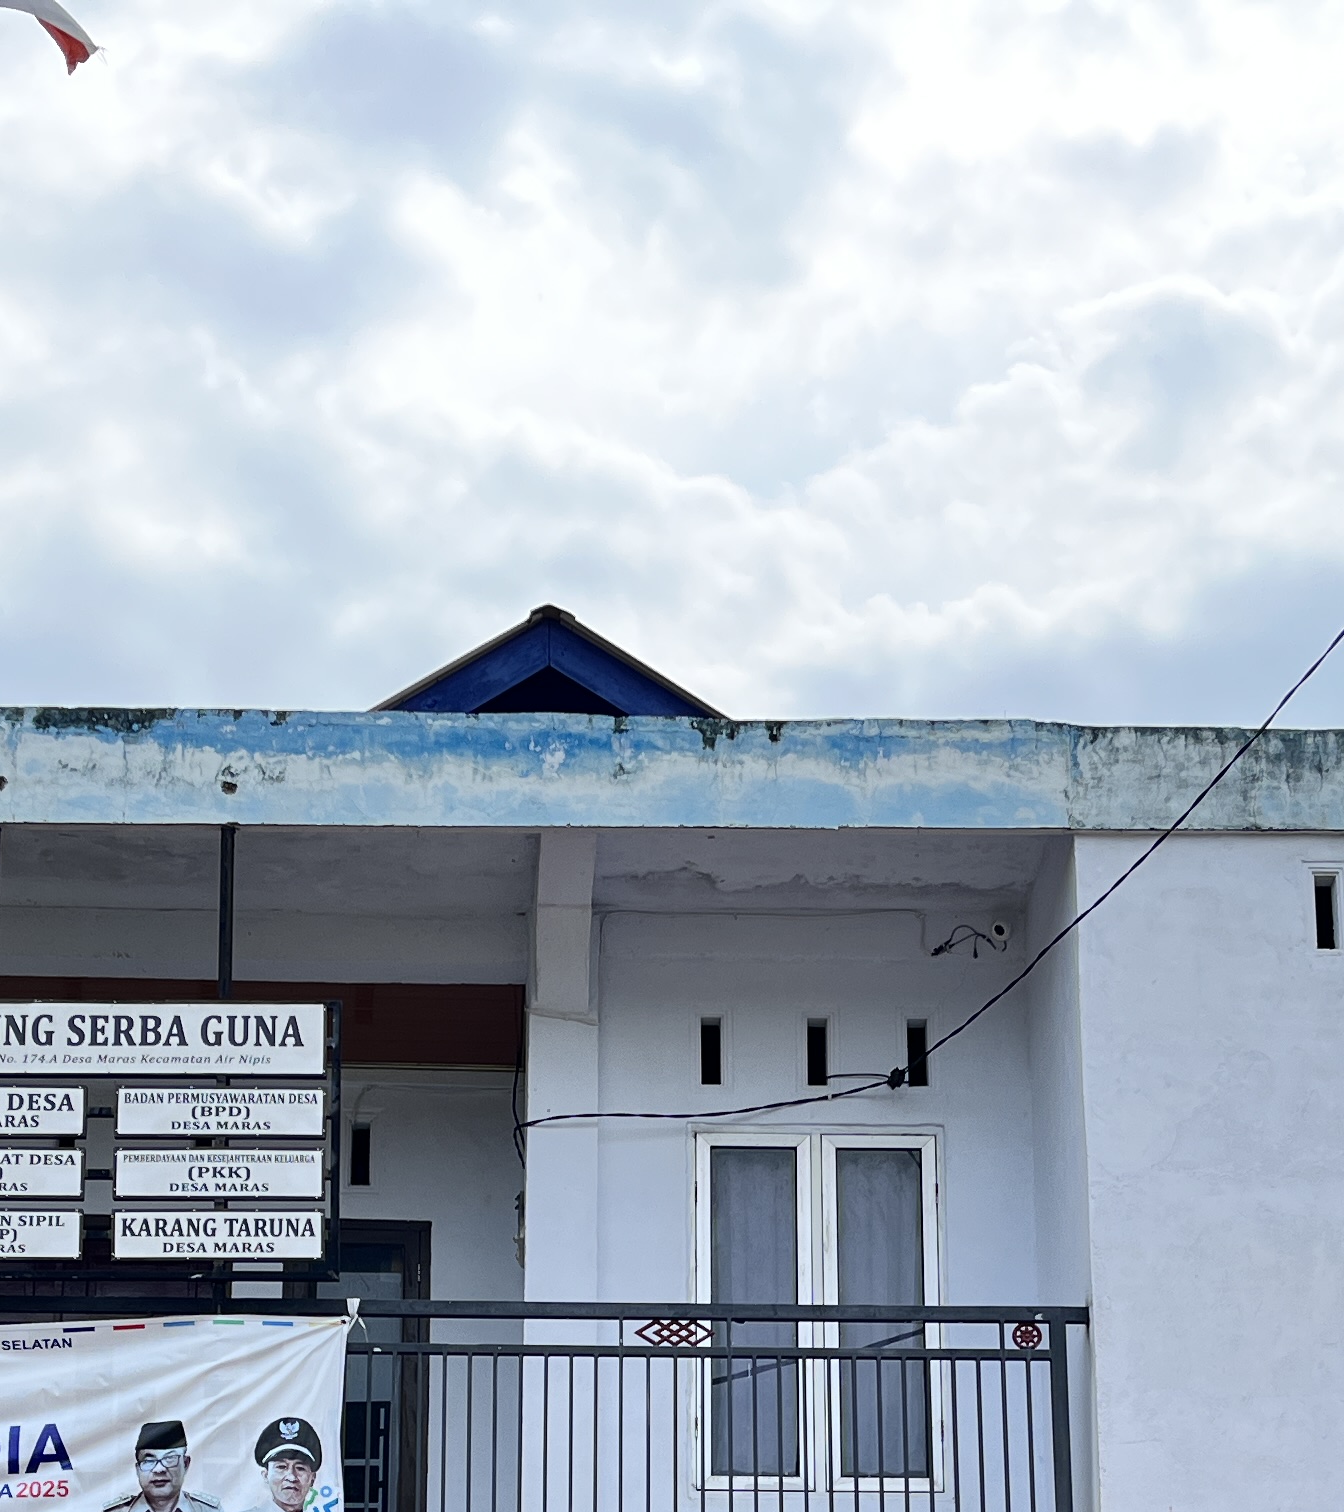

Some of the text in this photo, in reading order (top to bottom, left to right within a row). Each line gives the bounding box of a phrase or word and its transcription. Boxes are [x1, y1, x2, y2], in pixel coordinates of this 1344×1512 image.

[66, 1014, 189, 1047] SERBA
[200, 1015, 305, 1047] GUNA
[63, 1053, 92, 1064] Desa
[96, 1054, 136, 1064] Maras
[140, 1054, 211, 1064] Kecamatan
[214, 1054, 235, 1064] Air
[238, 1054, 272, 1066] Nipis
[7, 1093, 75, 1112] DESA
[124, 1092, 318, 1105] BADAN PERMUSYAWARATAN DESA
[191, 1105, 251, 1120] (BPD)
[170, 1121, 271, 1130] DESA MARAS
[29, 1153, 76, 1166] DESA
[188, 1154, 205, 1163] DAN
[188, 1166, 251, 1181] (PKK)
[169, 1182, 270, 1192] DESA MARAS
[17, 1214, 65, 1227] SIPIL
[121, 1218, 316, 1237] KARANG TARUNA
[162, 1242, 275, 1253] DESA MARAS
[1, 1337, 74, 1351] SELATAN
[15, 1480, 70, 1499] 2025
